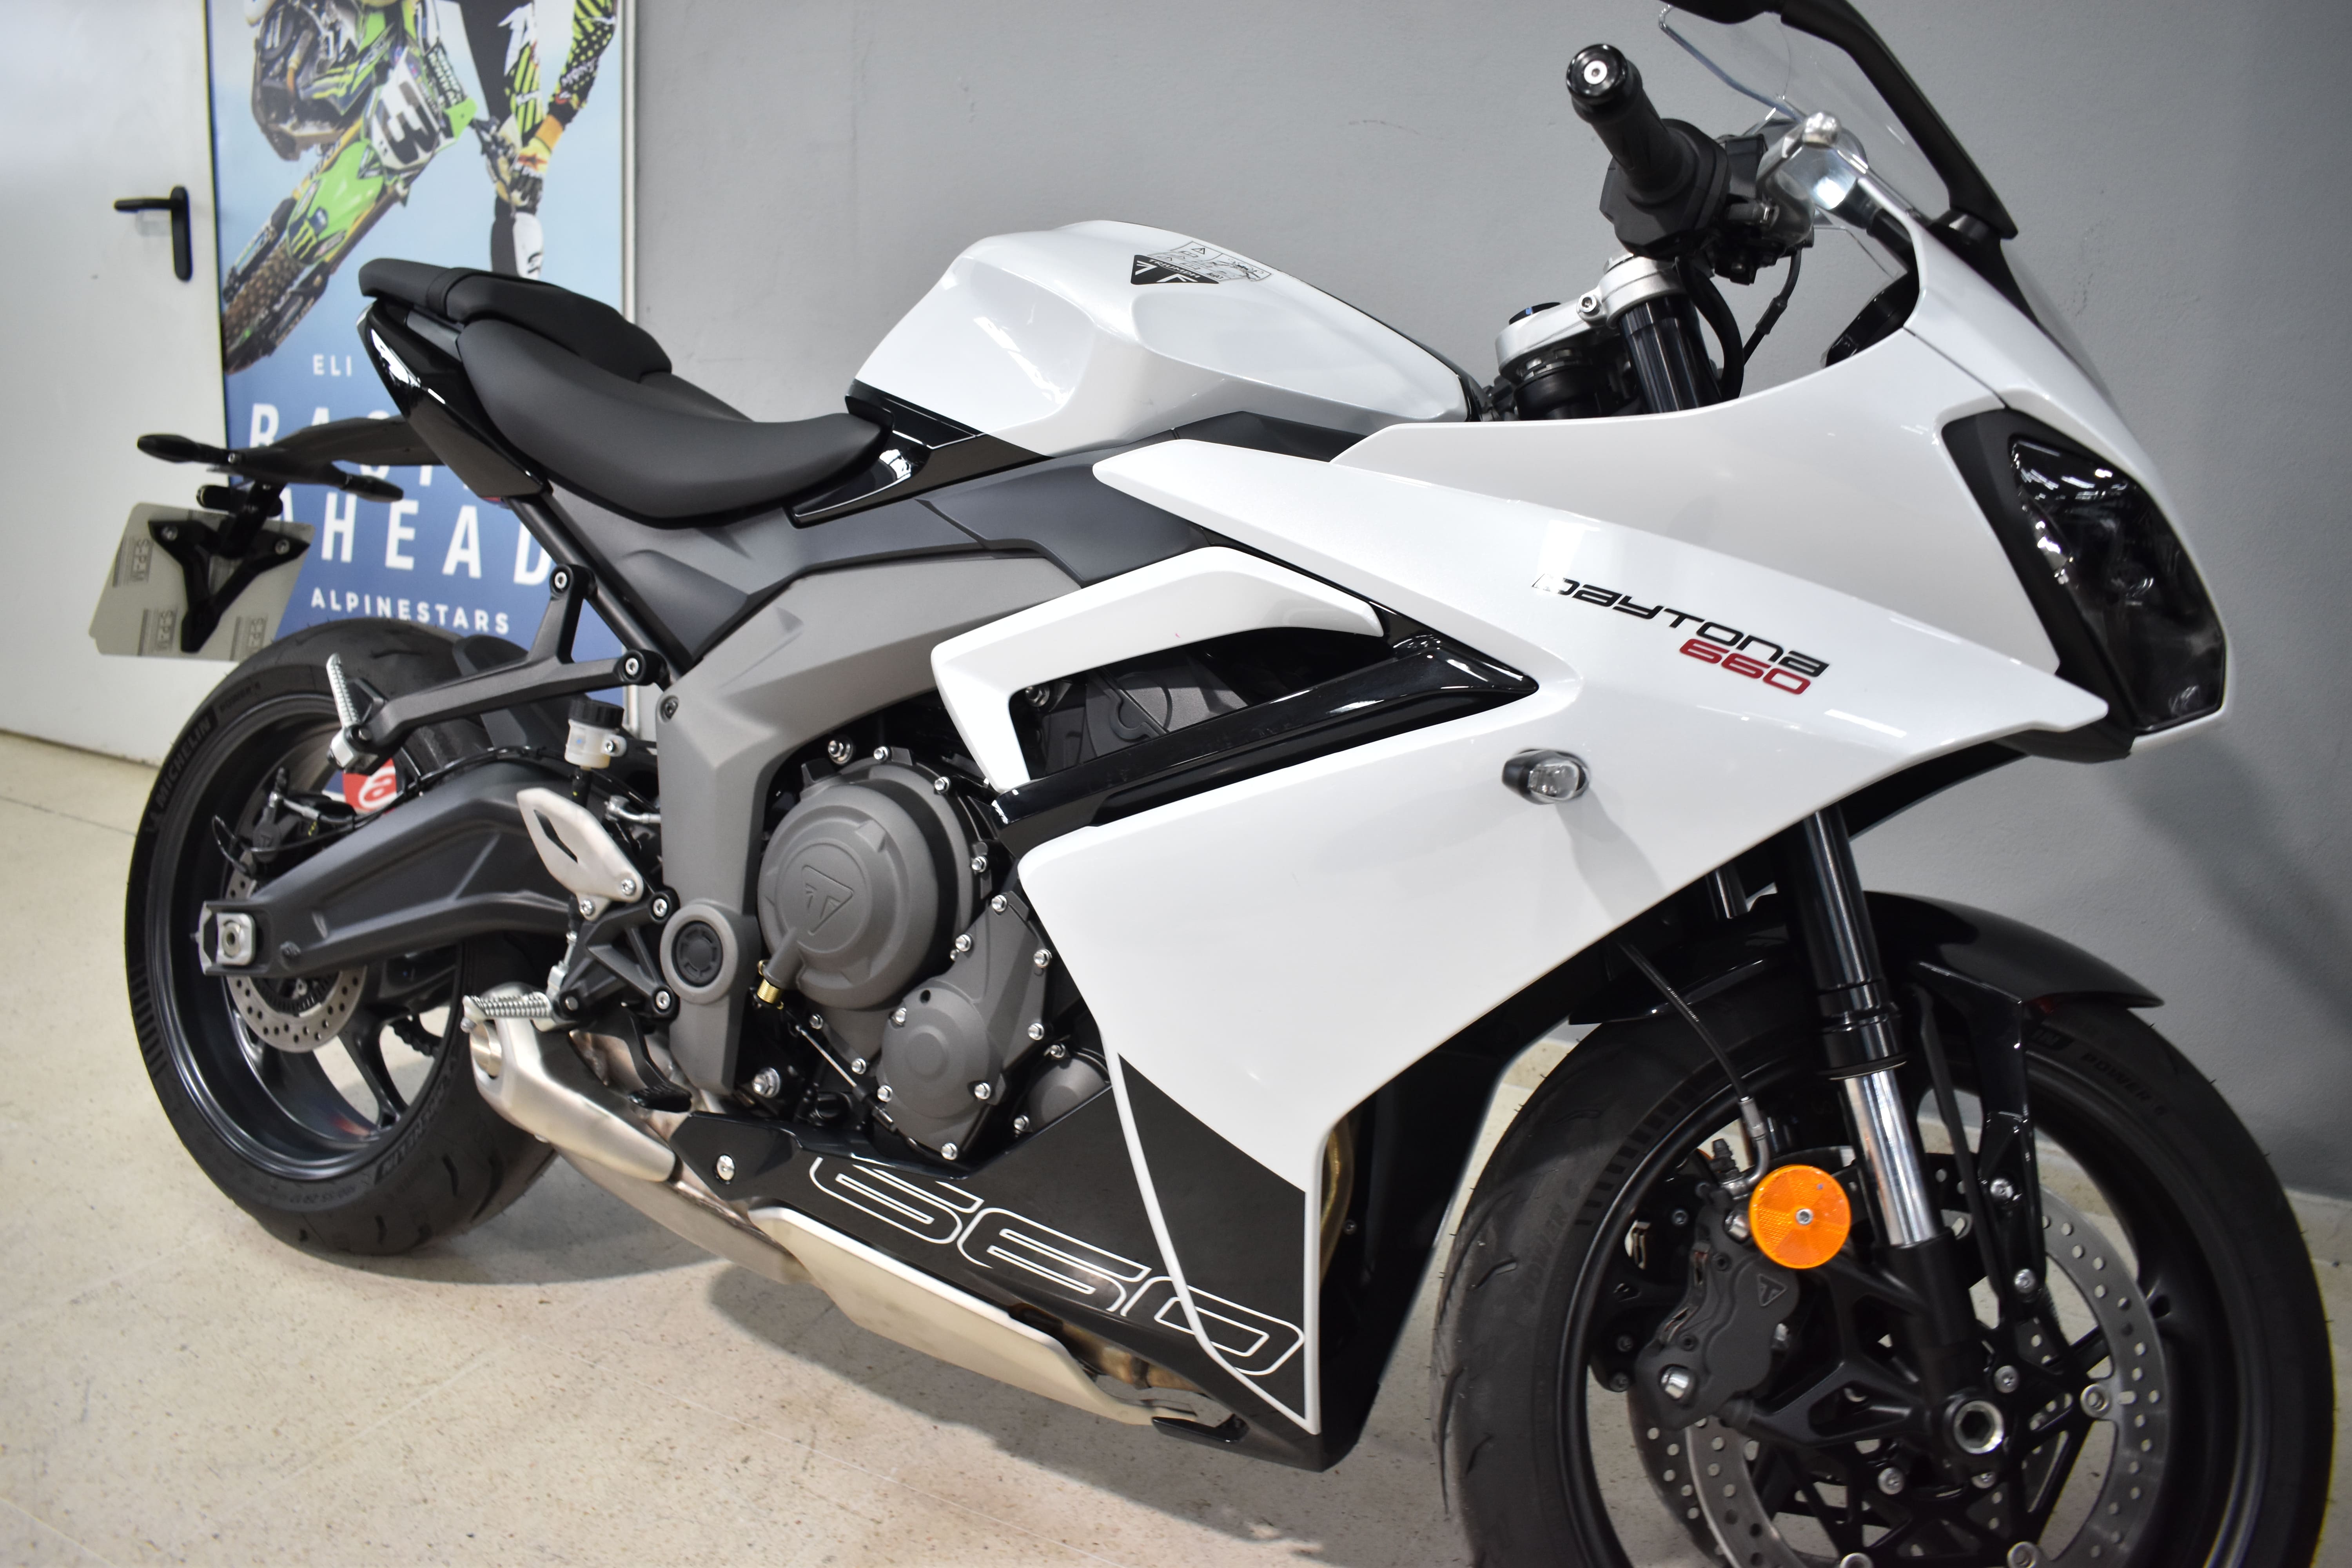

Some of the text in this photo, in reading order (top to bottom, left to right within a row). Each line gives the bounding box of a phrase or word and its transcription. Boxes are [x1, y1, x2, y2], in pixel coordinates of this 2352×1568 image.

[1149, 259, 1201, 278] TRIUMPH
[313, 354, 352, 376] ELI
[311, 588, 510, 633] ALPINESTARS
[1531, 573, 1830, 678] DAYTONA
[1679, 638, 1811, 695] 660
[156, 717, 212, 809] MICHELIN
